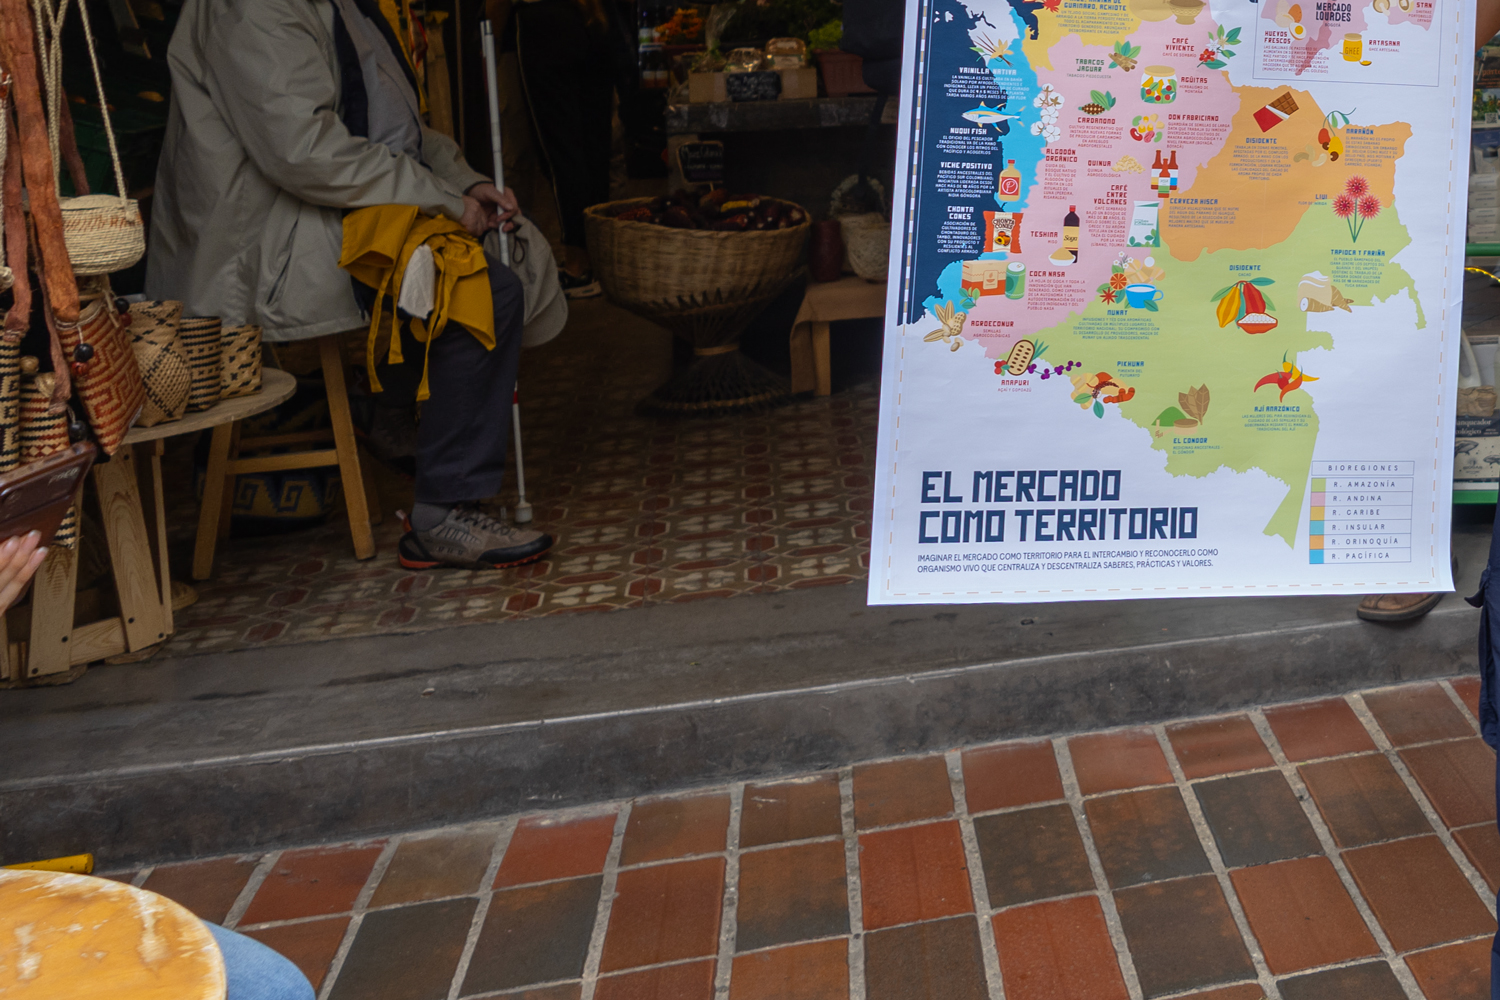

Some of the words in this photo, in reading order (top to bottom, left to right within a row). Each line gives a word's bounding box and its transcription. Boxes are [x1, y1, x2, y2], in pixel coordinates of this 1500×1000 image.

[1316, 2, 1351, 12] MERCADO
[1315, 11, 1351, 22] LOURDES
[1368, 39, 1400, 47] RATASANA
[1165, 44, 1195, 52] VIVIENTE
[1344, 46, 1360, 55] GHEE
[1075, 58, 1105, 66] TABACOS
[958, 66, 989, 75] VAINILLA
[1076, 65, 1102, 73] JAGUAR
[1180, 75, 1208, 84] AGÜITAS
[1077, 117, 1116, 125] CARDAMOMO
[1168, 113, 1181, 121] DON
[971, 127, 987, 135] FISH
[1045, 147, 1076, 155] ALGODÓN
[1045, 155, 1078, 163] ORGÁNICO
[940, 161, 960, 169] VICHE
[961, 162, 993, 170] POSITIVO
[947, 205, 974, 213] CHONTA
[1030, 230, 1058, 238] TESHIMA
[920, 470, 963, 504] EL
[971, 469, 1122, 503] MERCADO
[1347, 479, 1395, 488] AMAZONÍA
[1346, 508, 1380, 516] CARIBE
[918, 509, 1006, 544] COMO
[1014, 506, 1198, 542] TERRITORIO
[1345, 536, 1398, 545] ORINOQUÍA
[917, 552, 952, 562] IMAGINAR
[953, 552, 961, 561] EL
[962, 552, 998, 561] MERCADO
[999, 551, 1022, 561] COMO
[1023, 551, 1063, 560] TERRITORIO
[1064, 550, 1082, 560] PARA
[1083, 550, 1091, 559] EL
[1092, 550, 1137, 559] INTERCAMBIO
[1139, 549, 1144, 558] Y
[1144, 549, 1196, 558] RECONOCERLO
[1197, 548, 1219, 557] COMO
[1345, 551, 1390, 559] PACÍFICA
[917, 563, 961, 573] ORGANISMO
[962, 563, 979, 572] VIVO
[981, 563, 996, 572] QUE
[997, 562, 1040, 571] CENTRALIZA
[1041, 562, 1046, 570] Y
[1046, 561, 1102, 570] DESCENTRALIZA
[1103, 560, 1136, 570] SABERES,
[1136, 559, 1176, 569] PRÁCTICAS
[1176, 559, 1181, 568] Y
[1182, 559, 1214, 568] VALORES.
